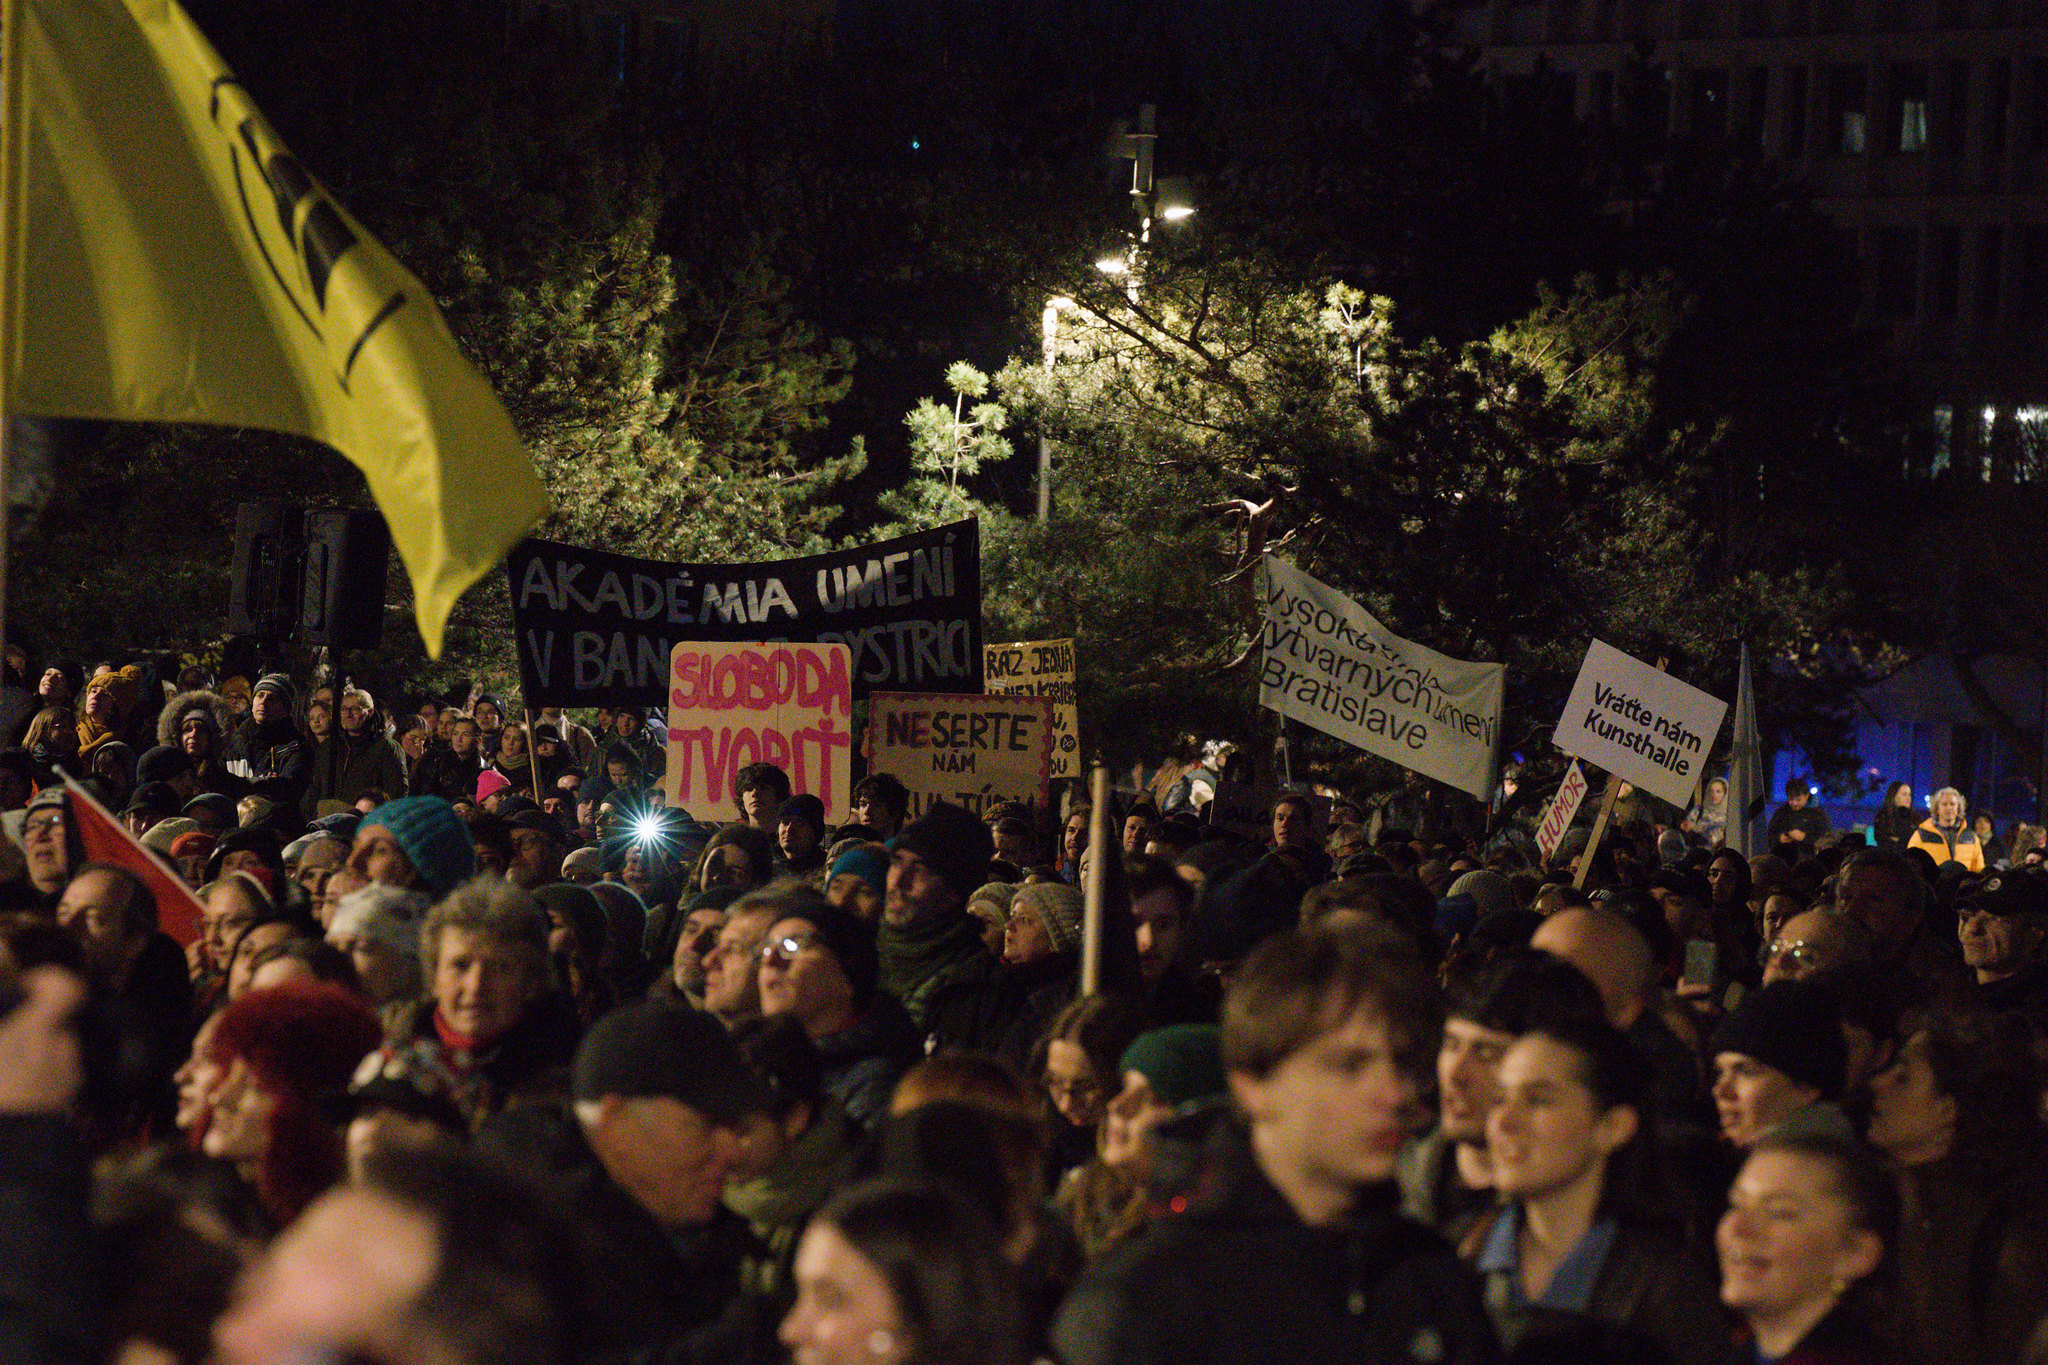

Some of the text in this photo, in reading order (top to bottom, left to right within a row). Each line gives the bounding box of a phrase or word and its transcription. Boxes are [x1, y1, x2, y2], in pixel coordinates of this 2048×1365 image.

[520, 532, 957, 624] AKADÉMIA UMENÍ
[526, 629, 554, 688] V
[817, 619, 972, 683] YSTRICI
[672, 647, 851, 716] SLOBODA
[986, 650, 1024, 680] RAZ
[886, 711, 1038, 751] NESERTE
[1260, 656, 1427, 749] Bratislave
[1594, 681, 1702, 753] Vráťte nám
[667, 718, 851, 818] TVORIŤ
[931, 748, 976, 774] NÁM
[1583, 708, 1690, 776] Kunsthalle
[1539, 771, 1585, 846] HUMOR
